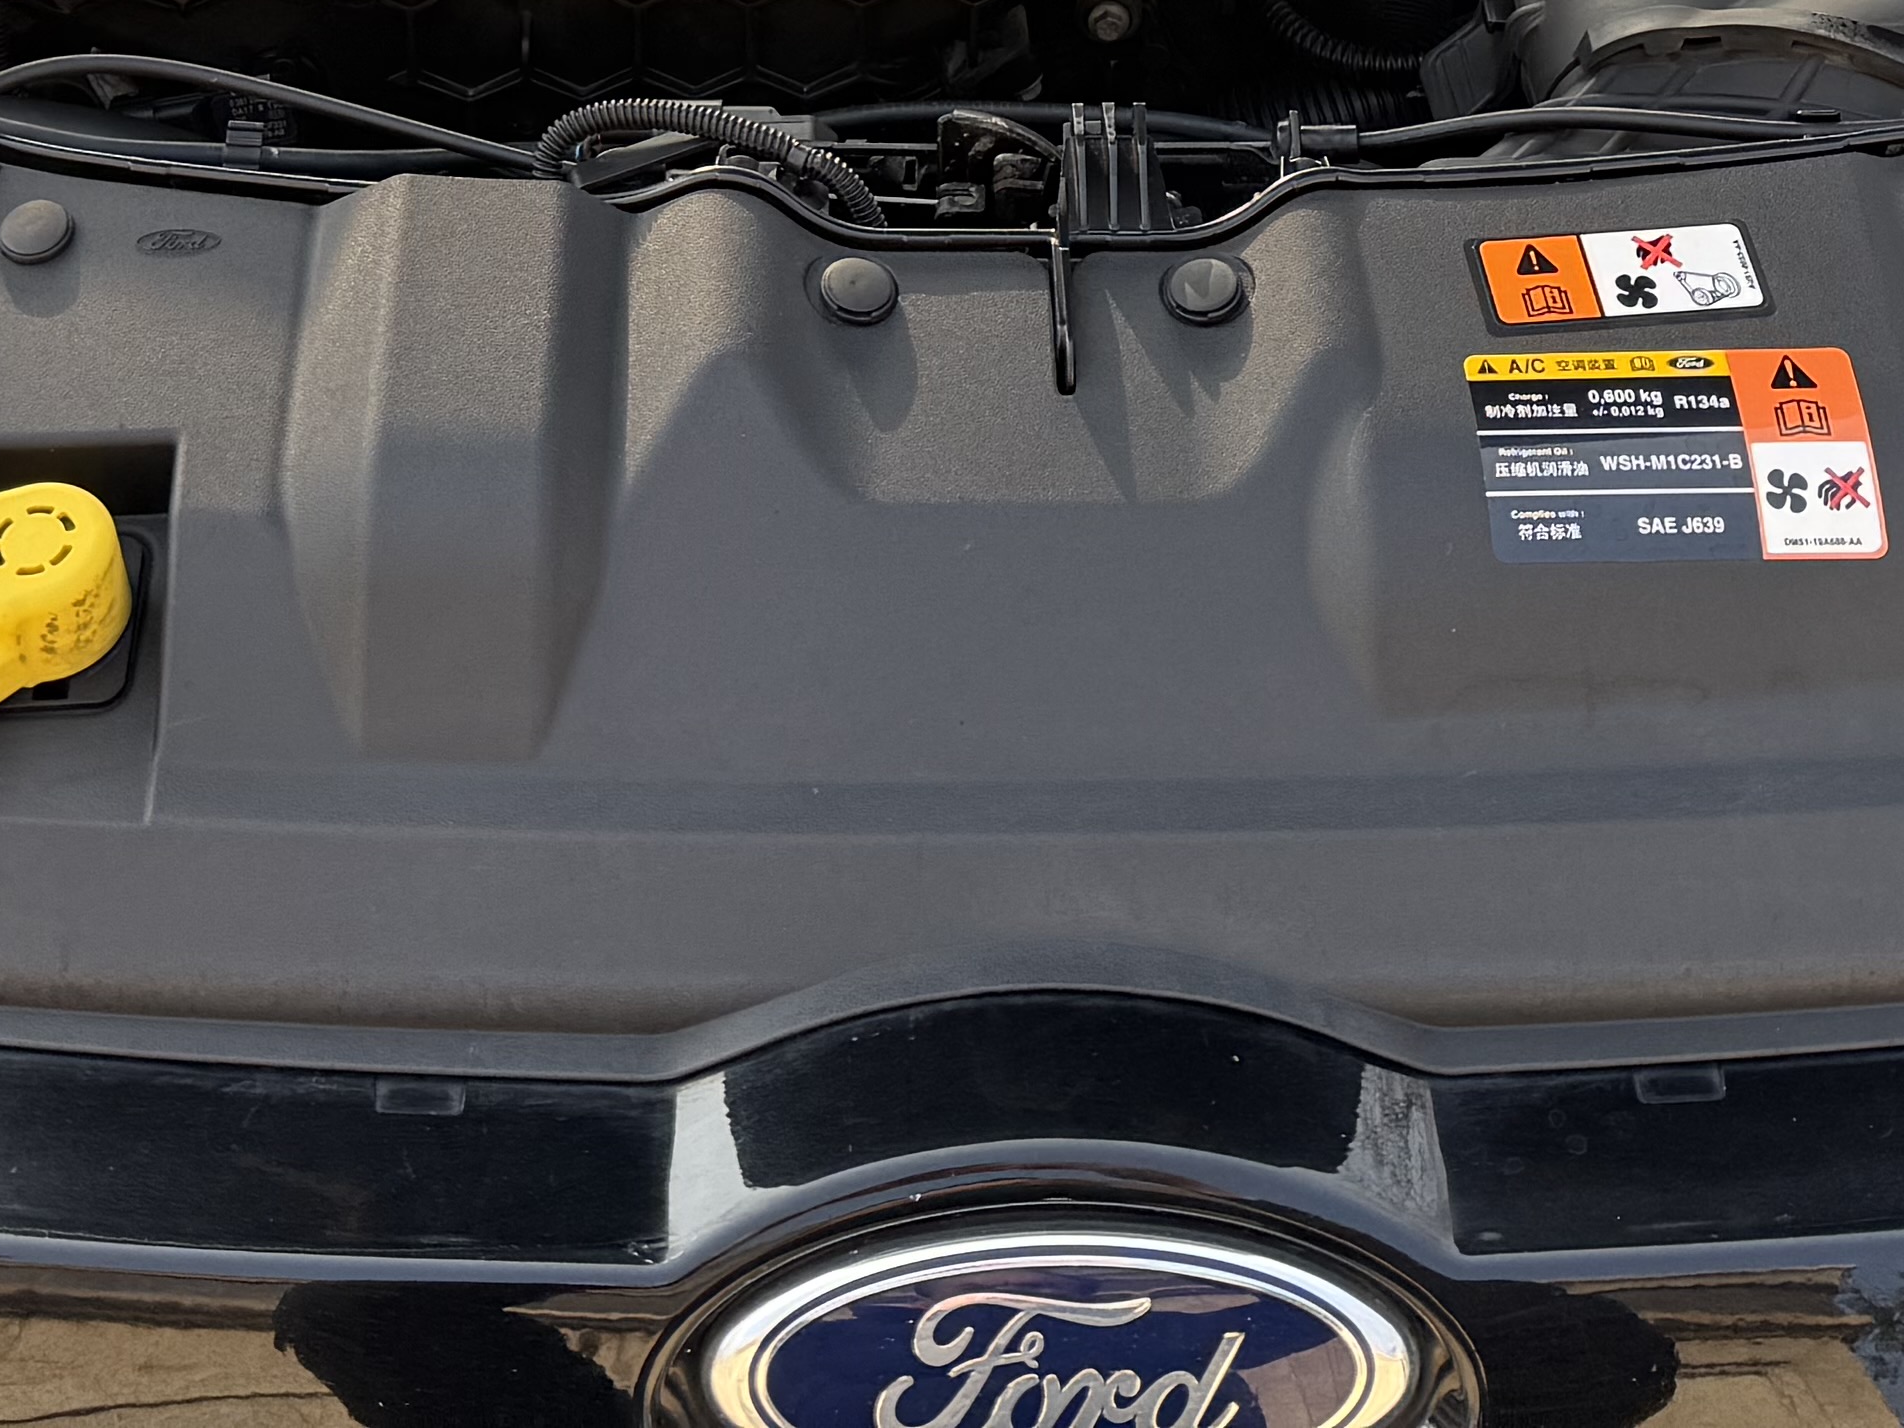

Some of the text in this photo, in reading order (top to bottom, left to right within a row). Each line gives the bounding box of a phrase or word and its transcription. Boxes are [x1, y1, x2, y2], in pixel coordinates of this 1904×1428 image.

[149, 230, 210, 251] Ford
[1508, 359, 1545, 374] A/C
[1555, 359, 1618, 372] 空调装置
[1639, 389, 1663, 405] kg
[1673, 394, 1731, 409] R134a
[1647, 405, 1665, 418] kg
[1495, 460, 1590, 478] 压缩机润滑油
[1599, 453, 1744, 472] WSH-M1C231-B
[1518, 522, 1583, 541] 符合标准
[1637, 515, 1726, 535] SAE J639
[876, 1291, 1246, 1428] Ford
